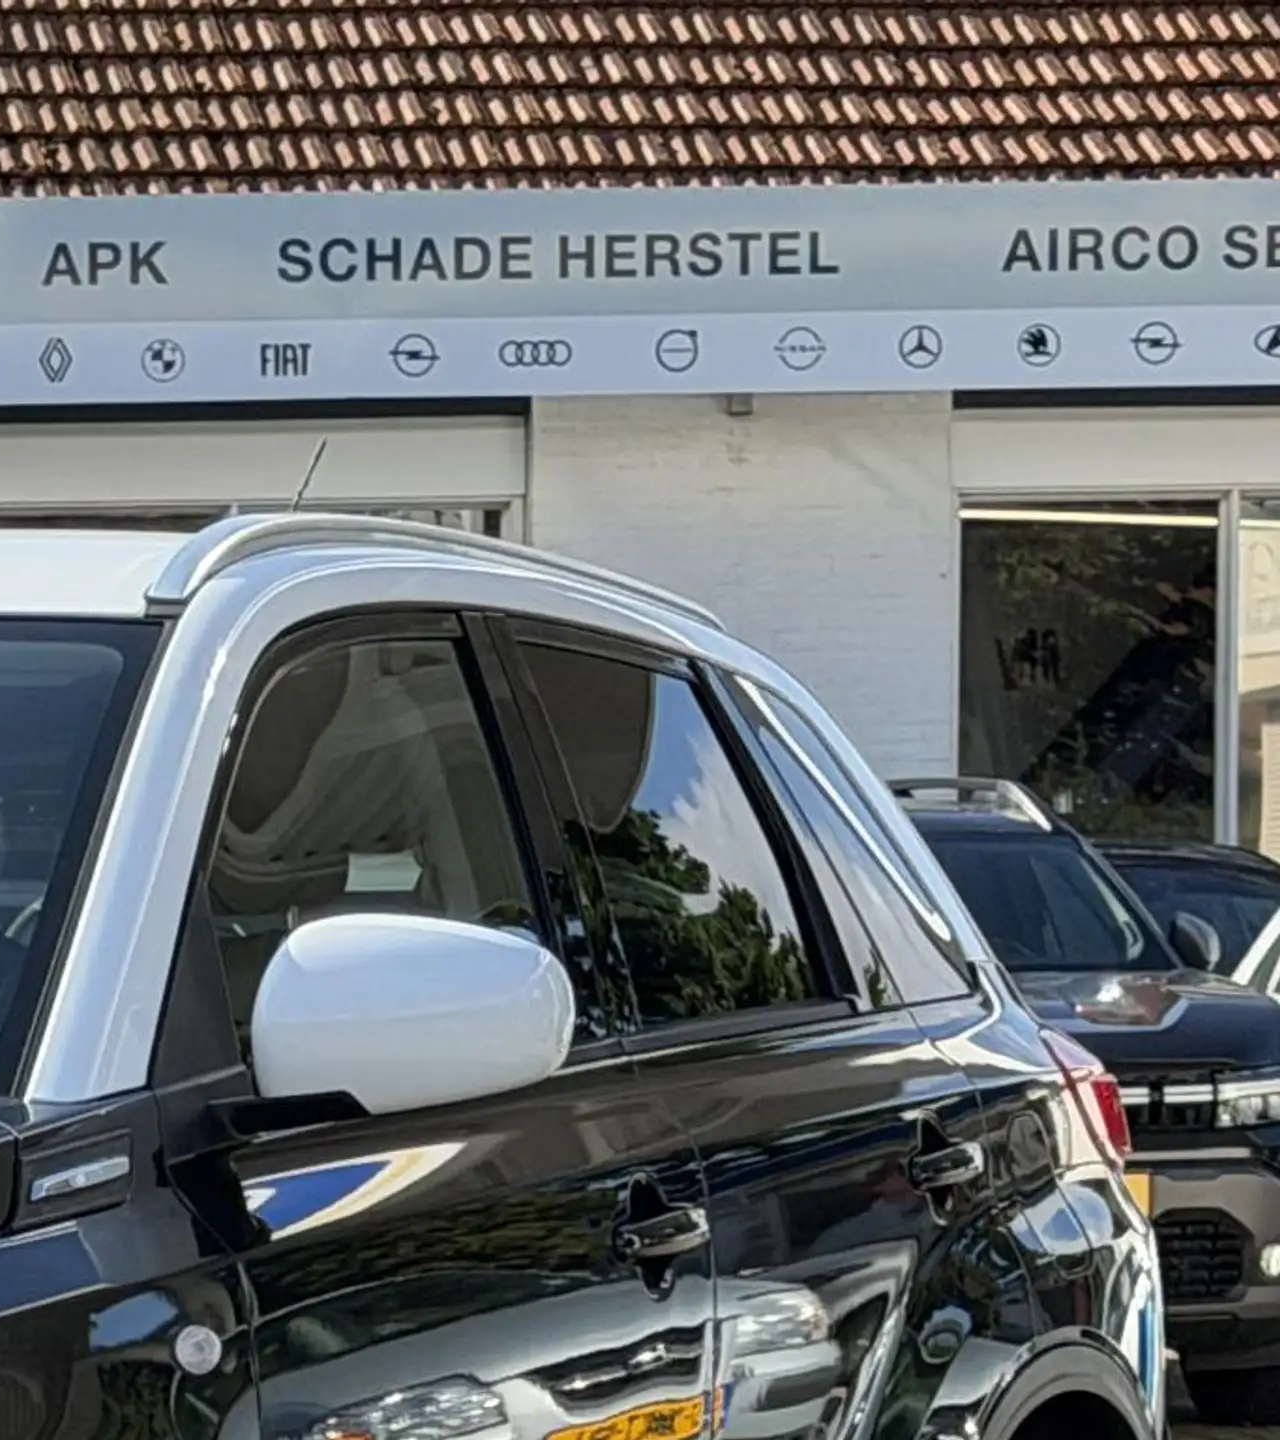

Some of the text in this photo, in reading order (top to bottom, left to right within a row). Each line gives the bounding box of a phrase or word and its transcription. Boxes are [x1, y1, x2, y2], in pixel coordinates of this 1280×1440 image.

[41, 241, 169, 286] APK
[277, 230, 840, 283] SCHADE HERSTEL
[1002, 224, 1200, 272] AIRCO
[260, 343, 312, 377] FIAT
